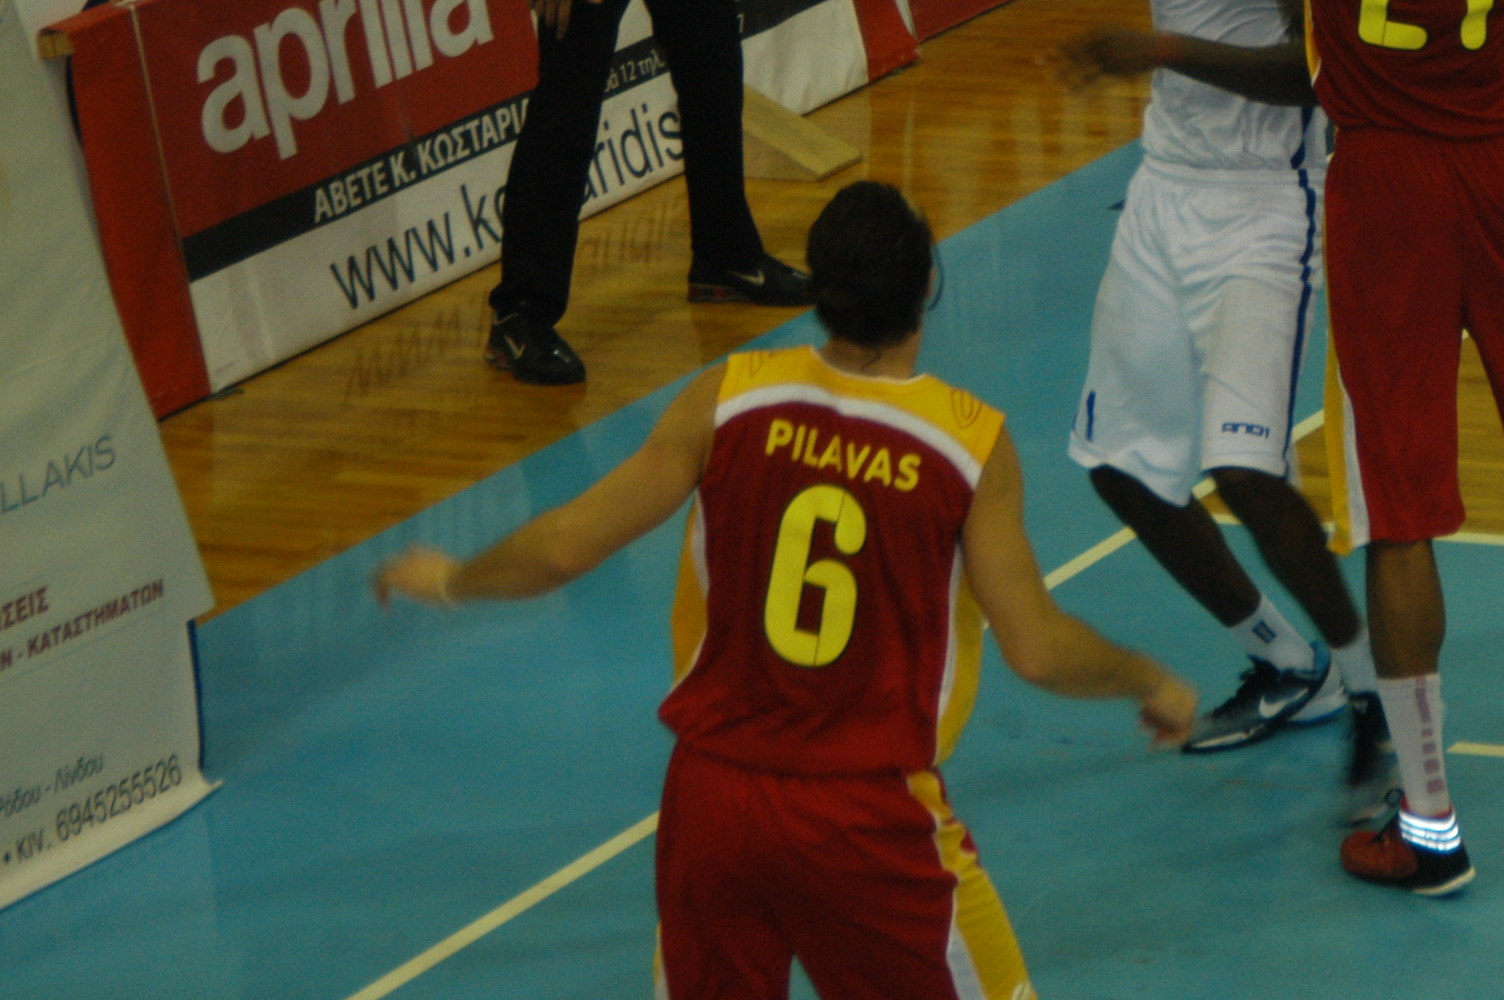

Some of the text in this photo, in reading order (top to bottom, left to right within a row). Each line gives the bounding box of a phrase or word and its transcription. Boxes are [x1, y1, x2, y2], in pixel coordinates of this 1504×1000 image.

[314, 161, 391, 223] ΑΒΕΤΕ
[764, 418, 922, 492] PILAVAS
[0, 586, 49, 631] ΣΕΙΣ
[763, 483, 868, 668] 6
[56, 754, 182, 842] 6945255526
